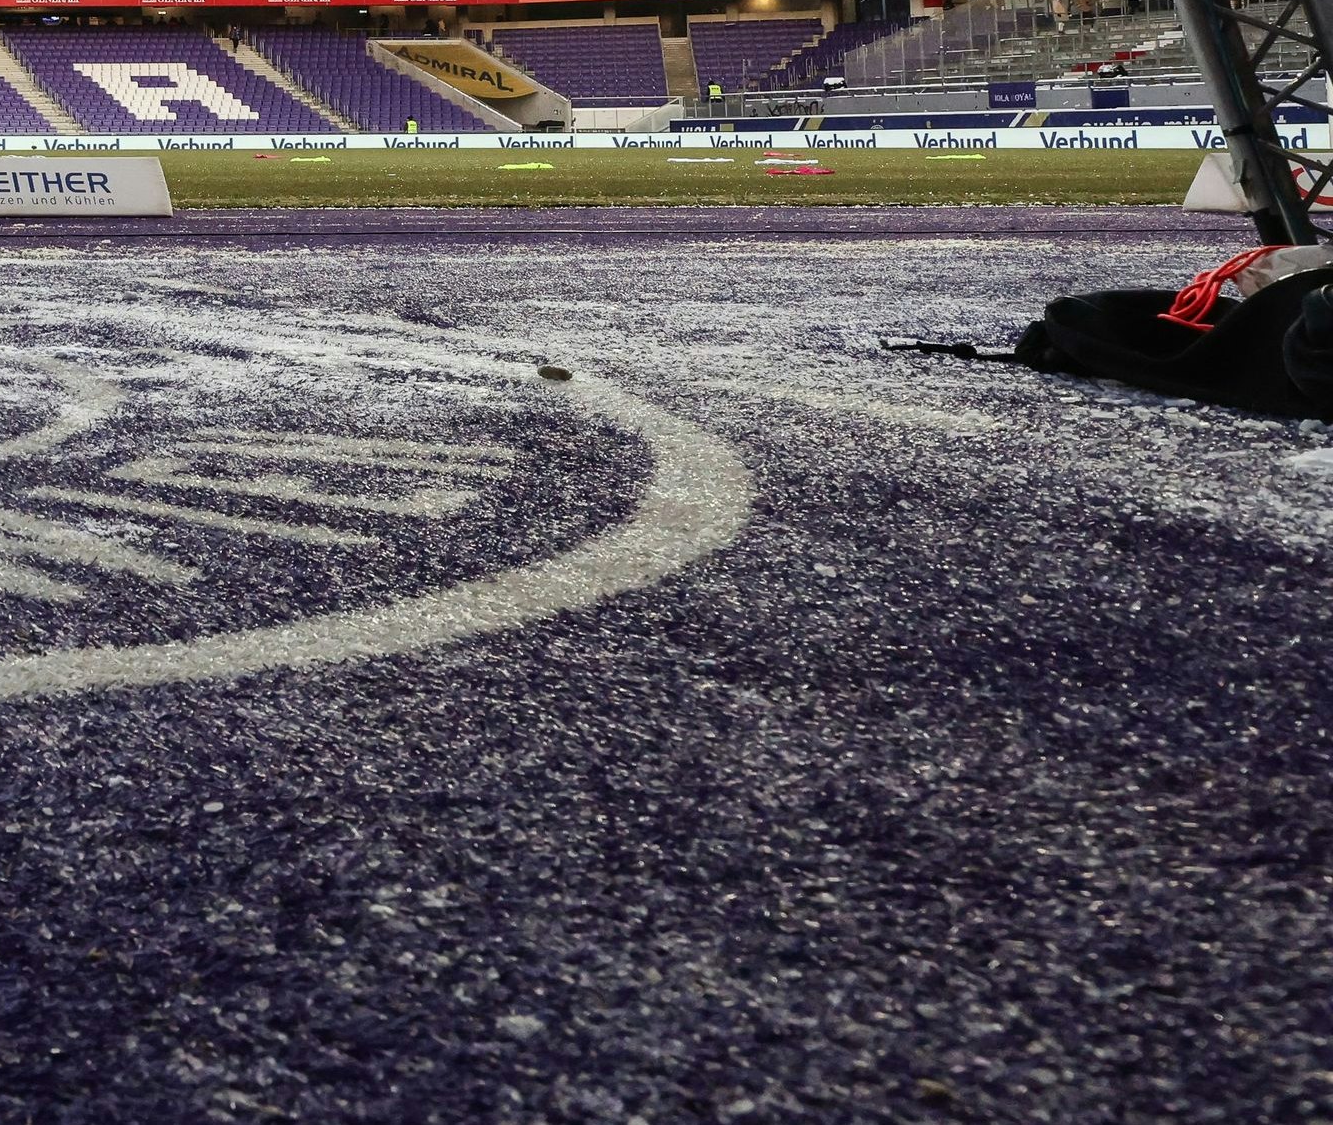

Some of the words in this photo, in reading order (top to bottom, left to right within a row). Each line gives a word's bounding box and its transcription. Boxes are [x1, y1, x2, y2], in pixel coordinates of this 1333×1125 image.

[395, 45, 513, 93] ADMIRAL
[43, 139, 120, 150] Verbund
[157, 138, 234, 149] Verbund
[270, 138, 347, 149] Verbund
[383, 137, 459, 148] Verbund
[497, 136, 574, 148] Verbund
[611, 136, 682, 148] Verbund
[709, 135, 773, 148] Verbund
[804, 133, 877, 148] Verbund
[913, 132, 997, 148] Verbund
[1039, 130, 1138, 149] Verbund
[31, 195, 57, 206] und
[65, 195, 116, 206] Kühlen
